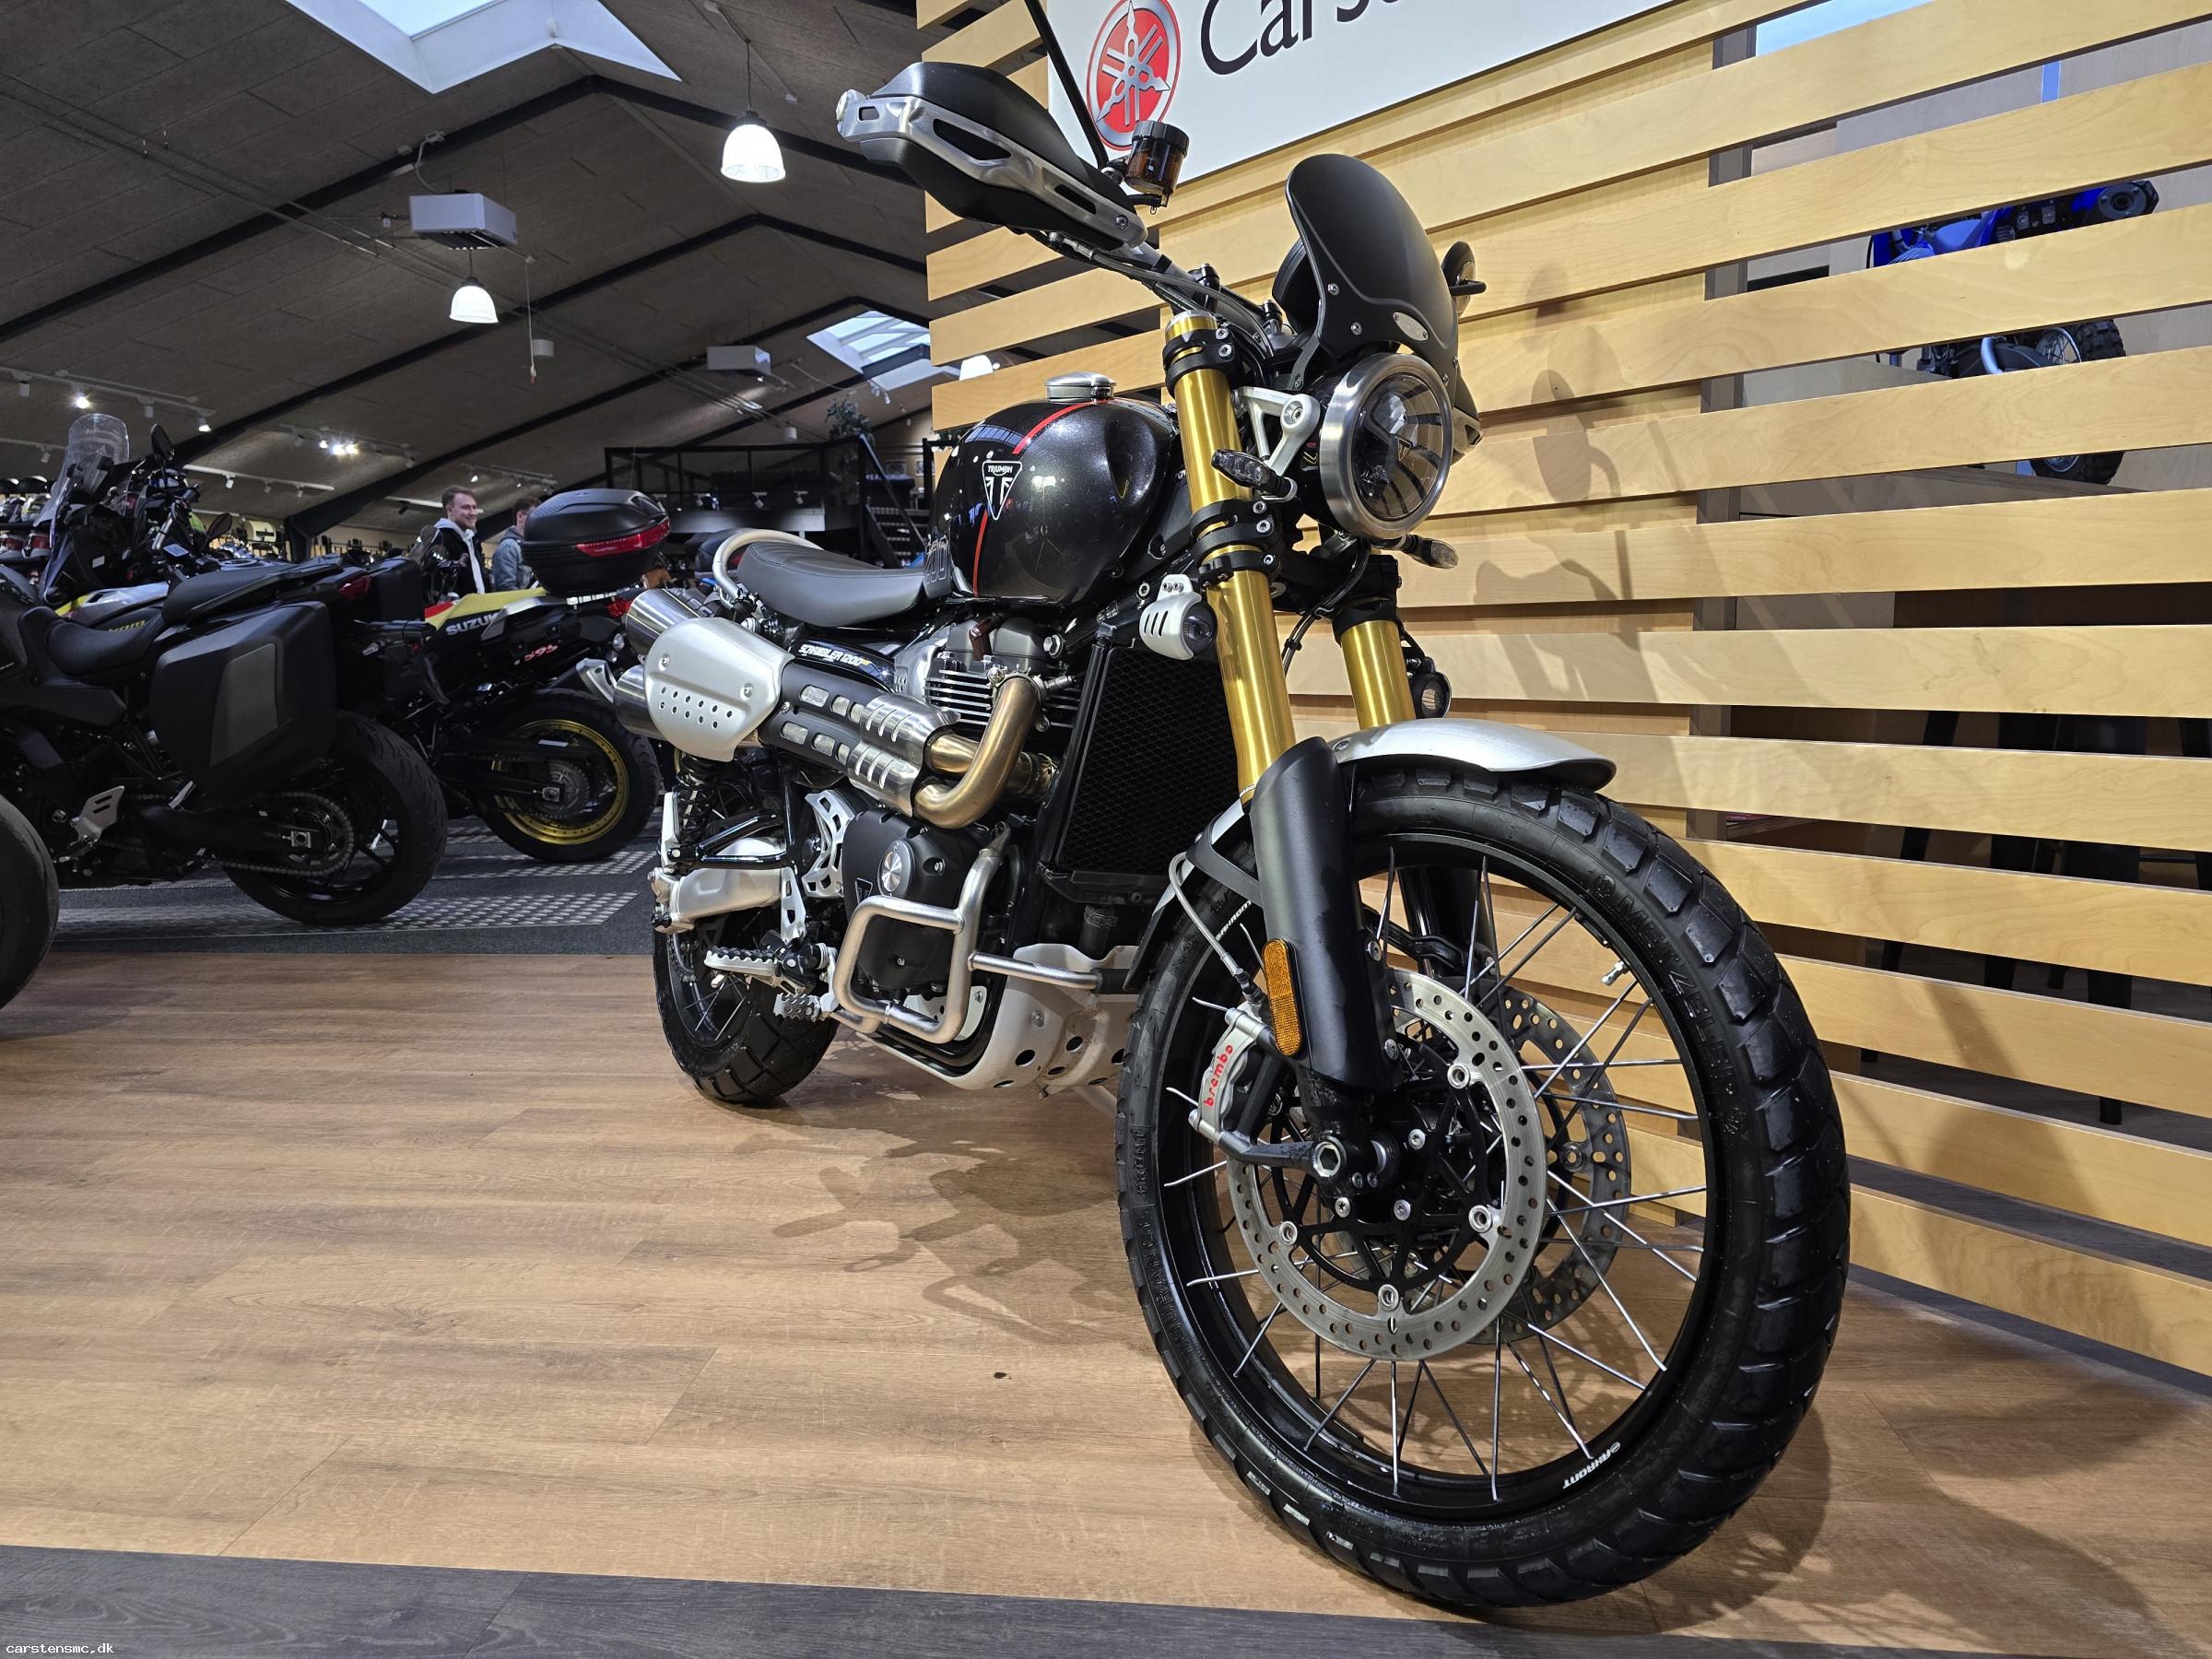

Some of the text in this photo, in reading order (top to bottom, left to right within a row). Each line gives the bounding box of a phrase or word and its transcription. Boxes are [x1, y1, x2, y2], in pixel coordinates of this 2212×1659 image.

[988, 465, 1013, 476] TRIUMPH
[445, 612, 499, 636] SUZUK
[798, 644, 841, 661] SCRAMBLER
[840, 653, 864, 666] 1200
[1203, 1044, 1233, 1107] brembo
[1134, 1131, 1149, 1197] FRONT
